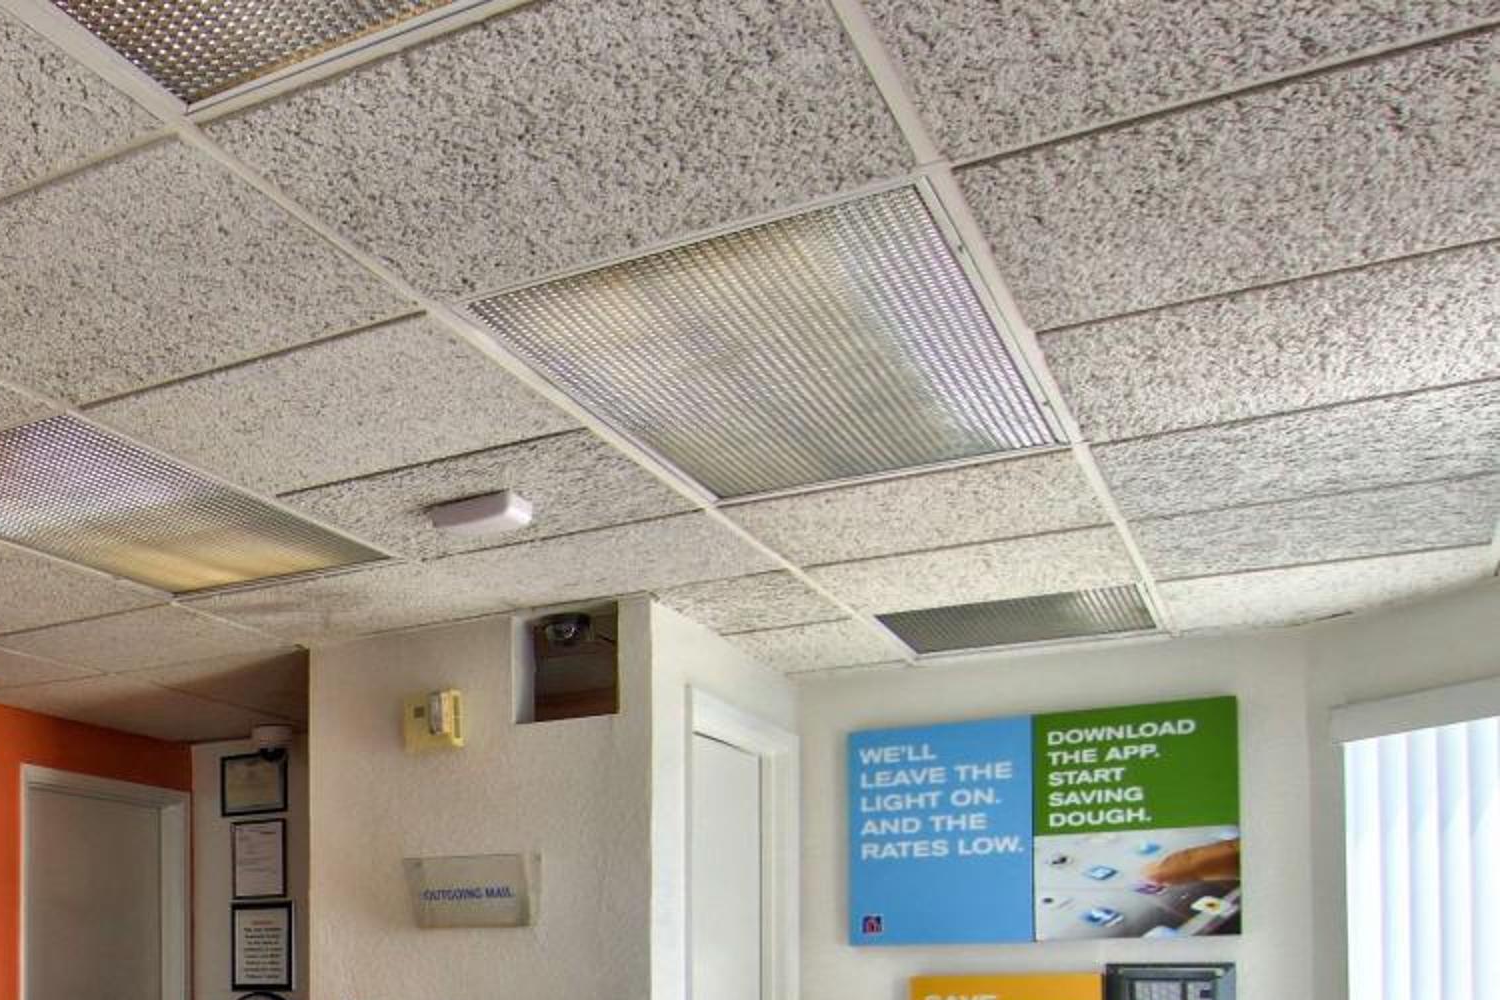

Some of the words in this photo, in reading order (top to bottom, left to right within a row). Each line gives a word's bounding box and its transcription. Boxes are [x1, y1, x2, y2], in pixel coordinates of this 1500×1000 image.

[1047, 718, 1196, 746] DOWNLOAD
[859, 743, 937, 765] WE'LL
[1048, 748, 1098, 767] THE
[1105, 743, 1161, 762] APP.
[860, 767, 947, 789] LEAVE
[954, 761, 1013, 782] THE
[1048, 767, 1125, 787] START
[860, 791, 942, 813] LIGHT
[951, 787, 1002, 807] ON.
[1048, 786, 1145, 807] SAVING
[861, 817, 921, 836] AND
[930, 813, 988, 833] THE
[1049, 808, 1153, 828] DOUGH.
[861, 839, 950, 861] RATES
[958, 835, 1025, 855] LOW.
[484, 885, 514, 899] MAIL
